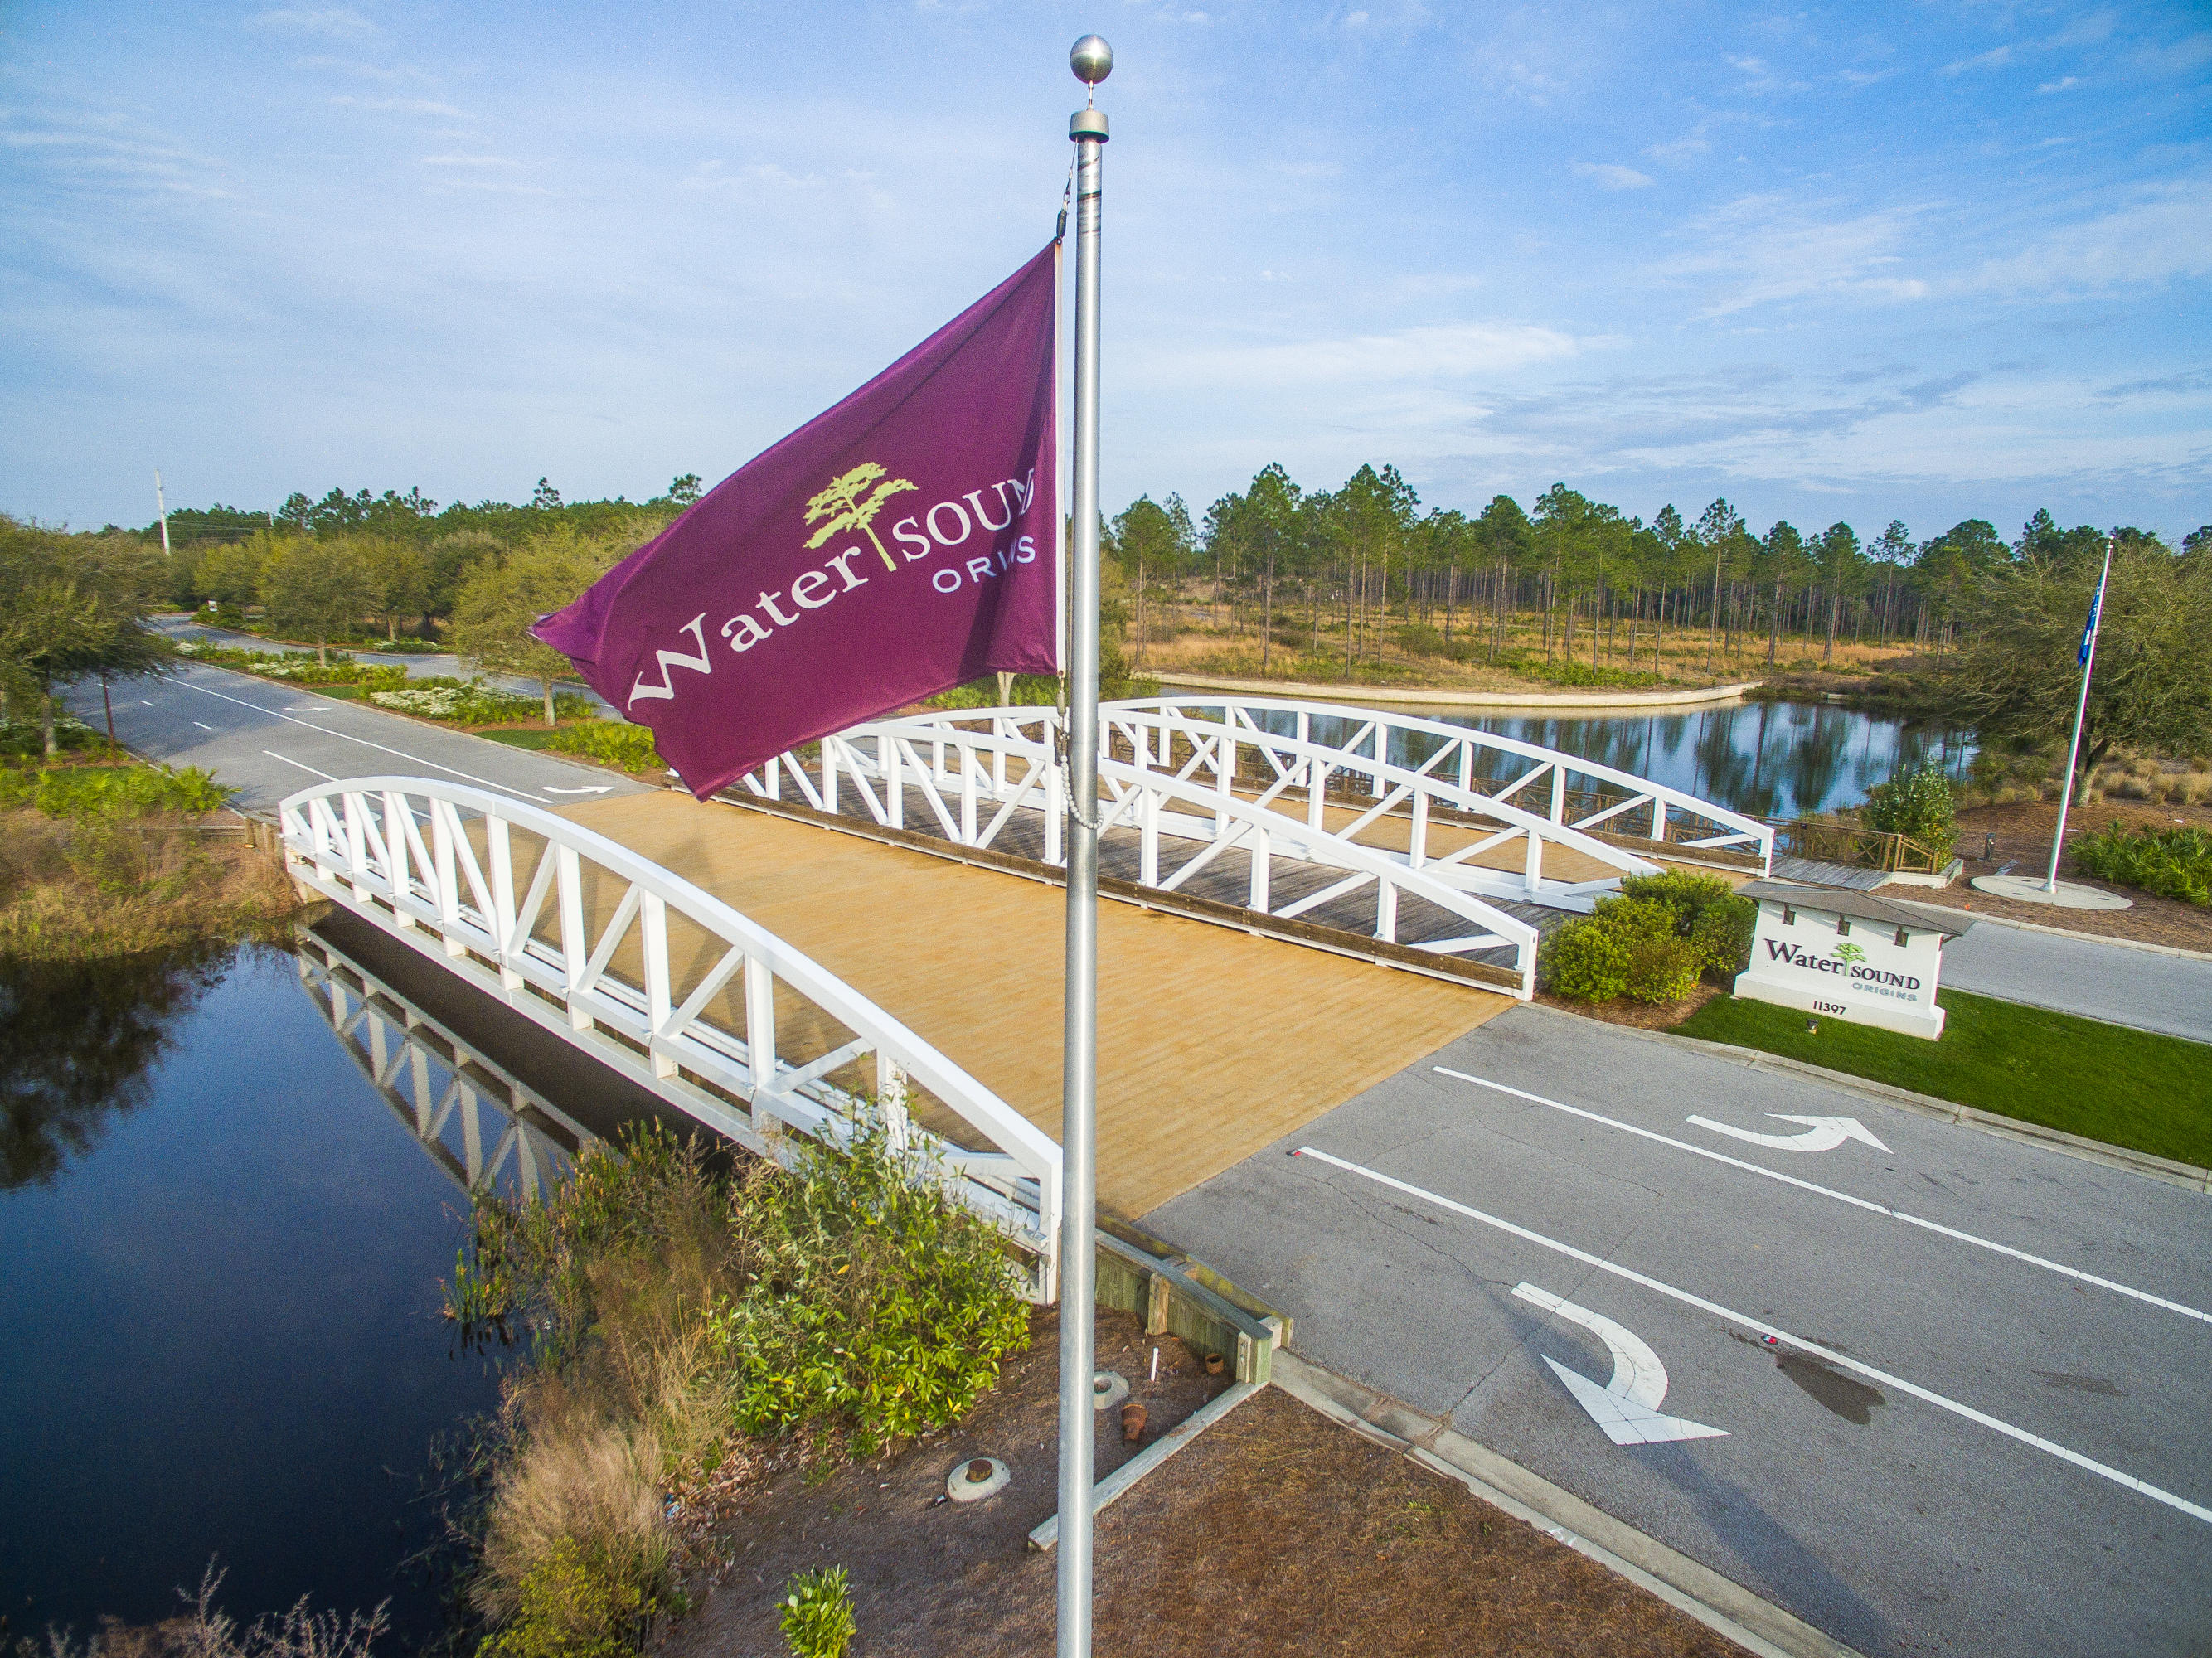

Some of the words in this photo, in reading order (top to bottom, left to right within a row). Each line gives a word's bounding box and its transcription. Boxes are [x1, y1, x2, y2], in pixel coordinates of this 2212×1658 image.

[628, 545, 870, 712] Water
[892, 468, 1035, 563] SOUN
[932, 536, 1036, 594] ORIS
[1763, 938, 1844, 974] Water
[1851, 966, 1920, 990] SOUND
[1813, 1000, 1846, 1015] 11397
[1852, 982, 1918, 1001] ORIGINS
